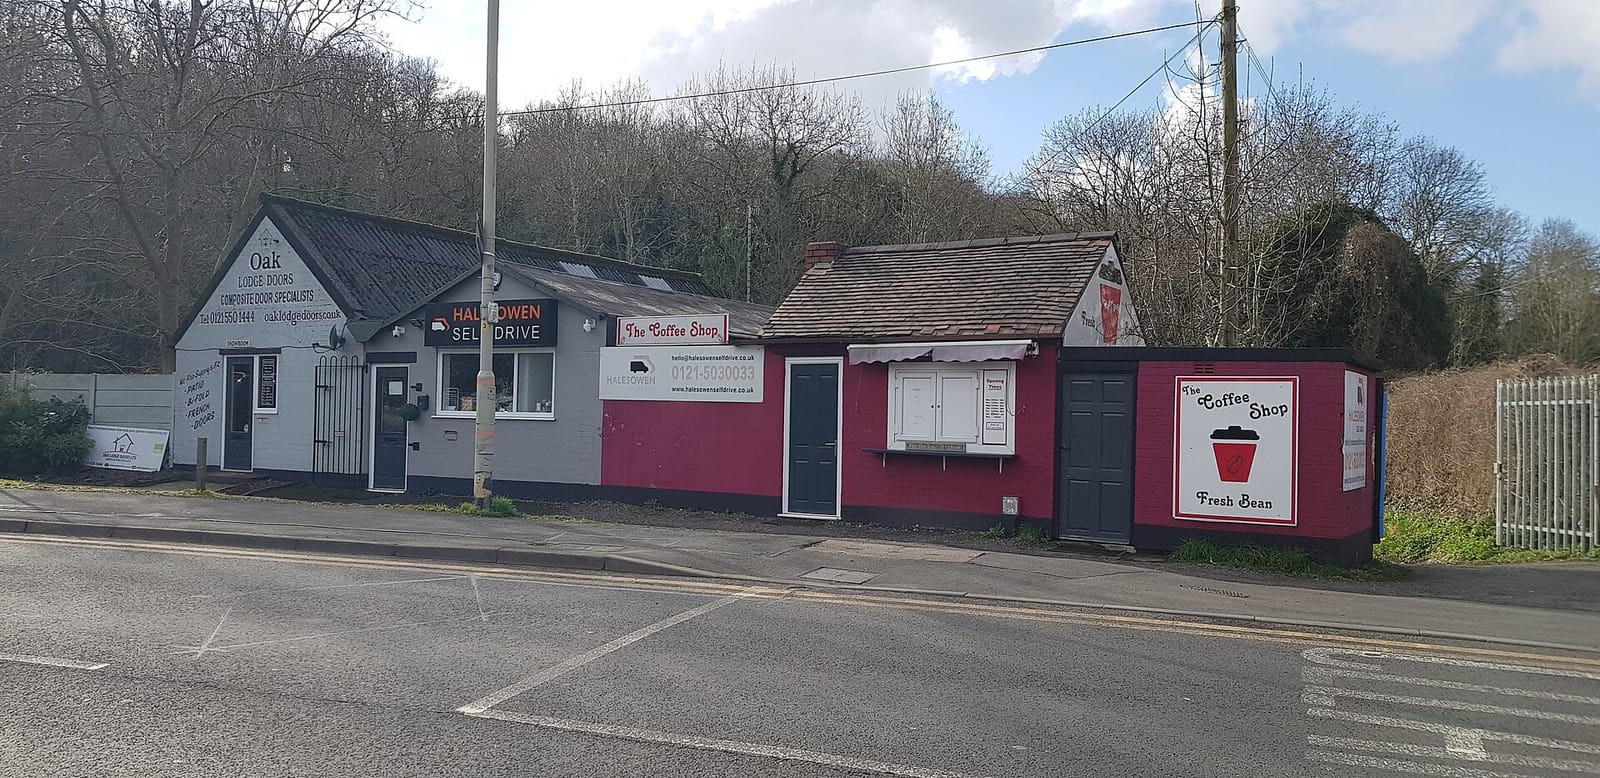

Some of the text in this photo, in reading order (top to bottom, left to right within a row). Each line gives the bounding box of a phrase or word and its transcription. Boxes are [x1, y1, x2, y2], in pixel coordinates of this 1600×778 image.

[250, 251, 281, 270] Oak
[238, 273, 294, 288] LODGE DOORS
[221, 290, 314, 306] COMPOSITE DOOR SPECIALISTS
[453, 304, 541, 321] HALOWEN
[452, 327, 479, 340] SEL
[495, 325, 541, 340] DRIVE
[625, 321, 718, 338] The Coffee Shop
[606, 375, 656, 385] HALESOWEN
[671, 365, 755, 380] 0121-5030033
[671, 386, 754, 394] www.halesowenselfdrive.co.uk
[1181, 385, 1201, 396] The
[1197, 392, 1250, 410] Coffee
[1249, 402, 1288, 420] Shop
[1196, 491, 1273, 510] Fresh Bean
